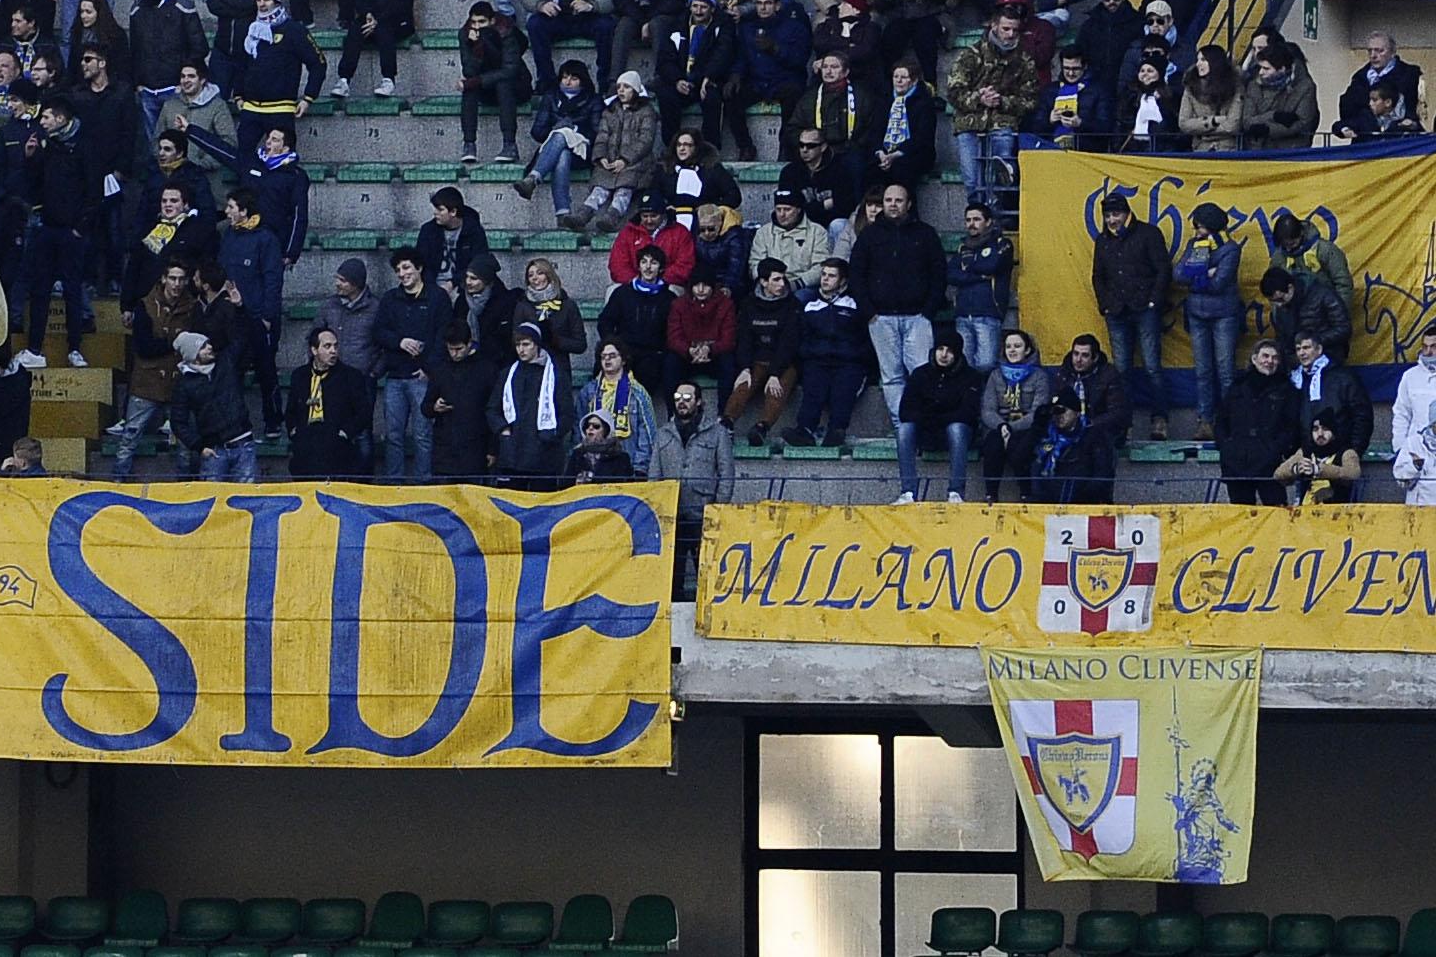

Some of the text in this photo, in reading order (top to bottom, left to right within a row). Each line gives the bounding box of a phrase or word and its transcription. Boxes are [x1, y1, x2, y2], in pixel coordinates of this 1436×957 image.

[1060, 529, 1144, 545] 2 0
[710, 533, 1022, 613] MILANO
[41, 490, 662, 758] SIDE
[1054, 599, 1136, 615] 0 8
